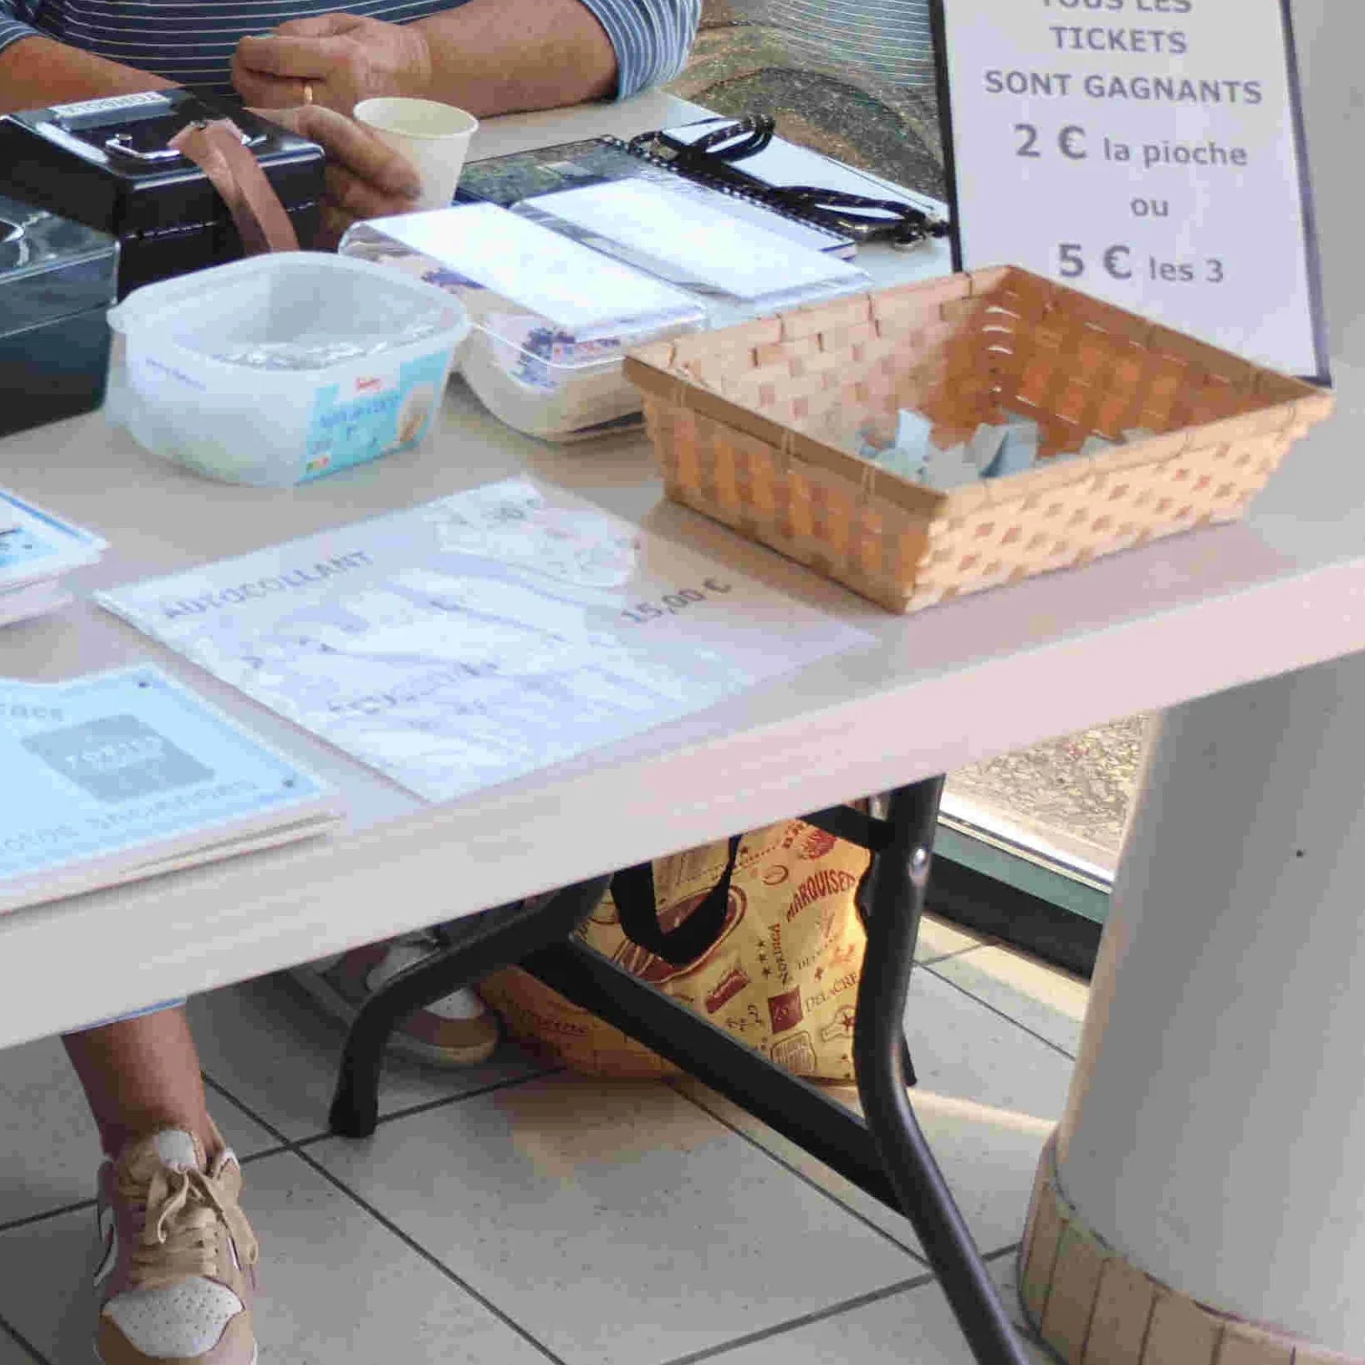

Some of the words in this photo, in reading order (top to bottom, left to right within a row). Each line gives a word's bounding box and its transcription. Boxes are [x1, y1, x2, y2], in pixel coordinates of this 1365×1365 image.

[1049, 26, 1188, 55] TICKETS
[984, 69, 1072, 97] SONT
[1084, 74, 1263, 105] GAGNANTS
[1013, 123, 1041, 159] 2
[1056, 125, 1088, 162] €
[1103, 137, 1131, 163] la
[1143, 141, 1249, 169] pioche
[1130, 197, 1170, 218] ou
[1057, 243, 1085, 279] 5
[1102, 244, 1134, 281] €
[1149, 257, 1194, 282] les
[1205, 259, 1224, 283] 3
[620, 588, 706, 624] 15,00
